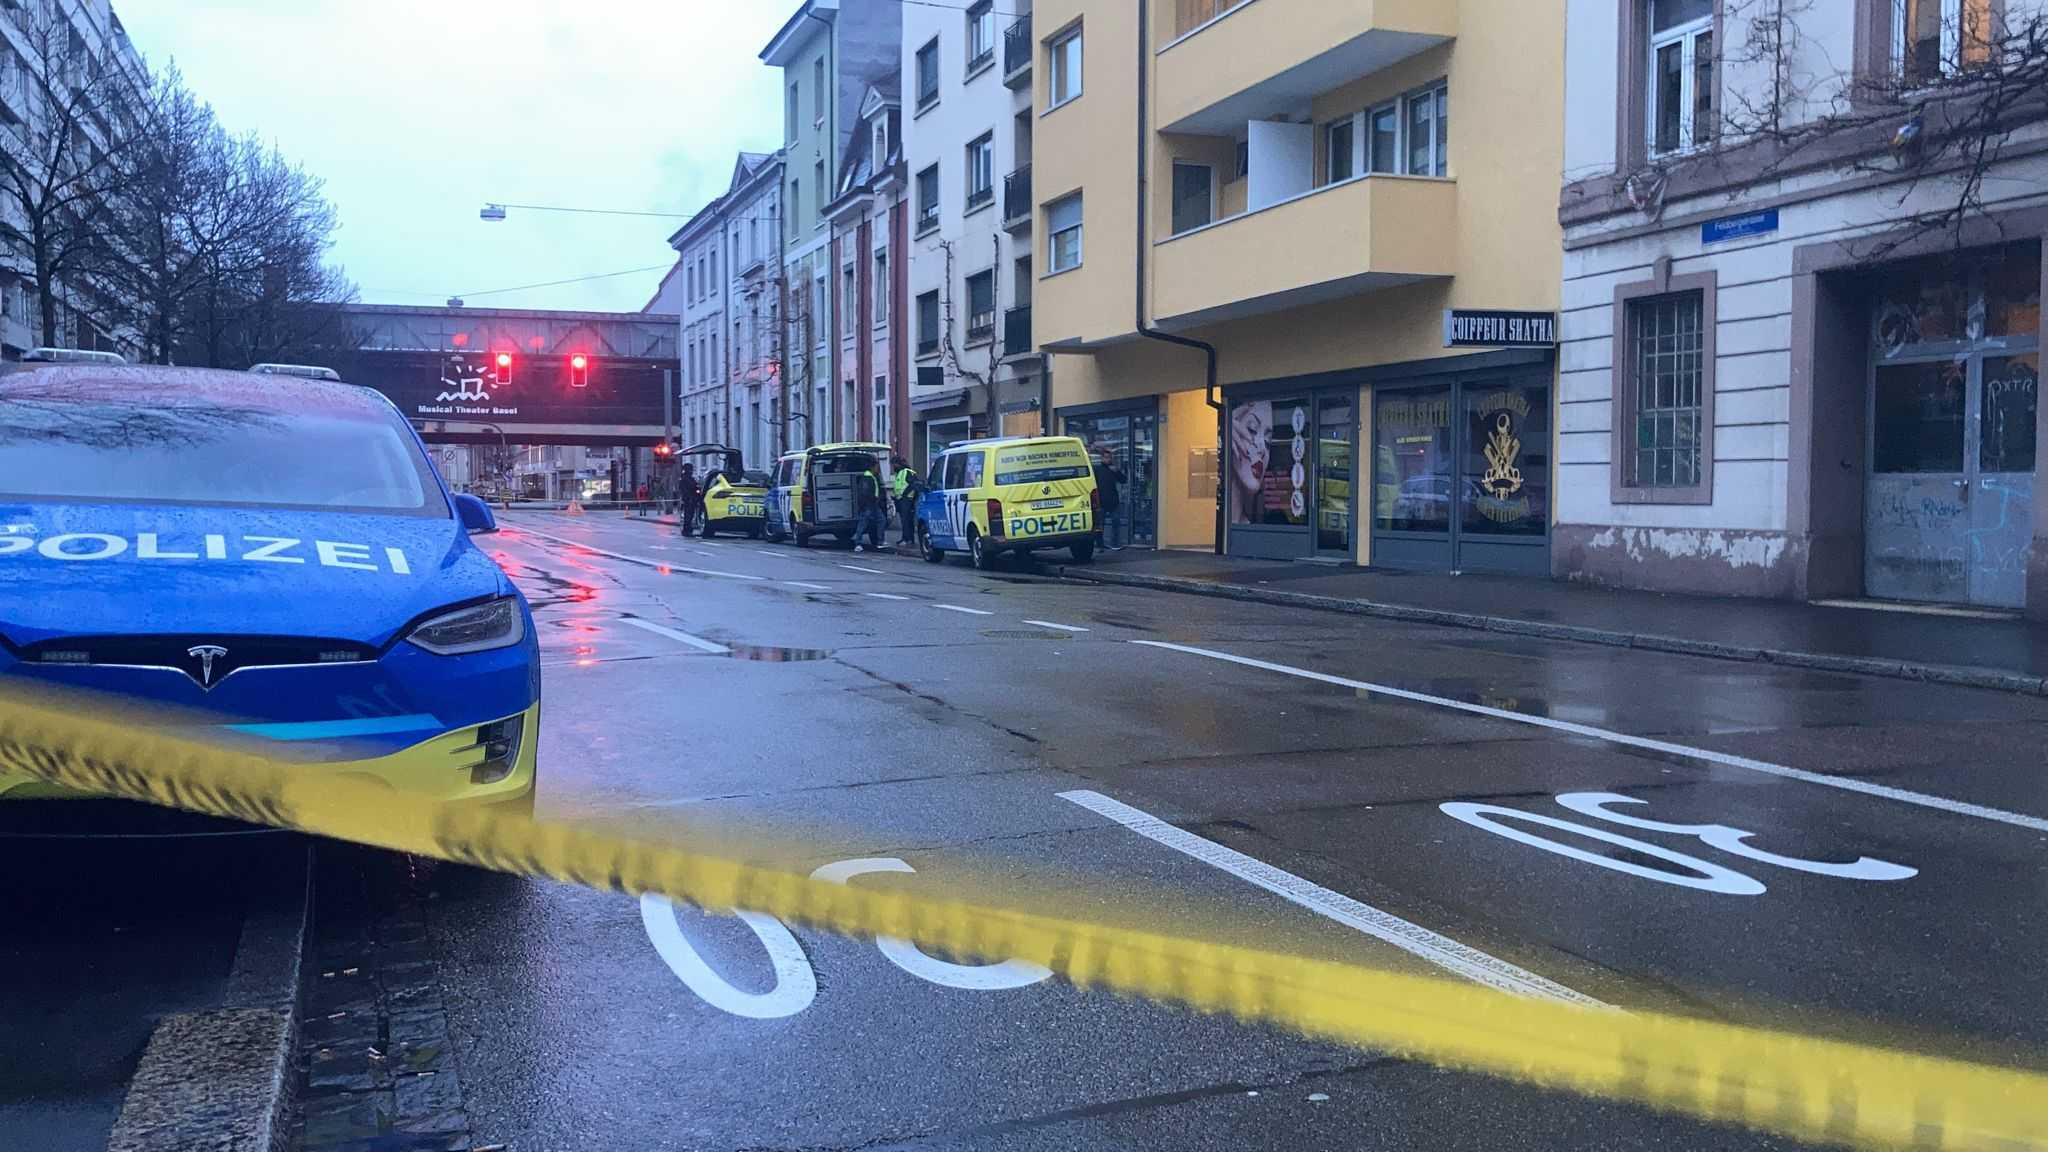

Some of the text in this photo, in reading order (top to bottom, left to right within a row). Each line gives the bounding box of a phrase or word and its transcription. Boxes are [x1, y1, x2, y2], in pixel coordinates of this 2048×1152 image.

[1451, 317, 1553, 342] COIFFEUR SHATHA
[418, 405, 453, 413] Musical
[455, 406, 490, 414] Theater
[1011, 512, 1087, 536] POLIZEI
